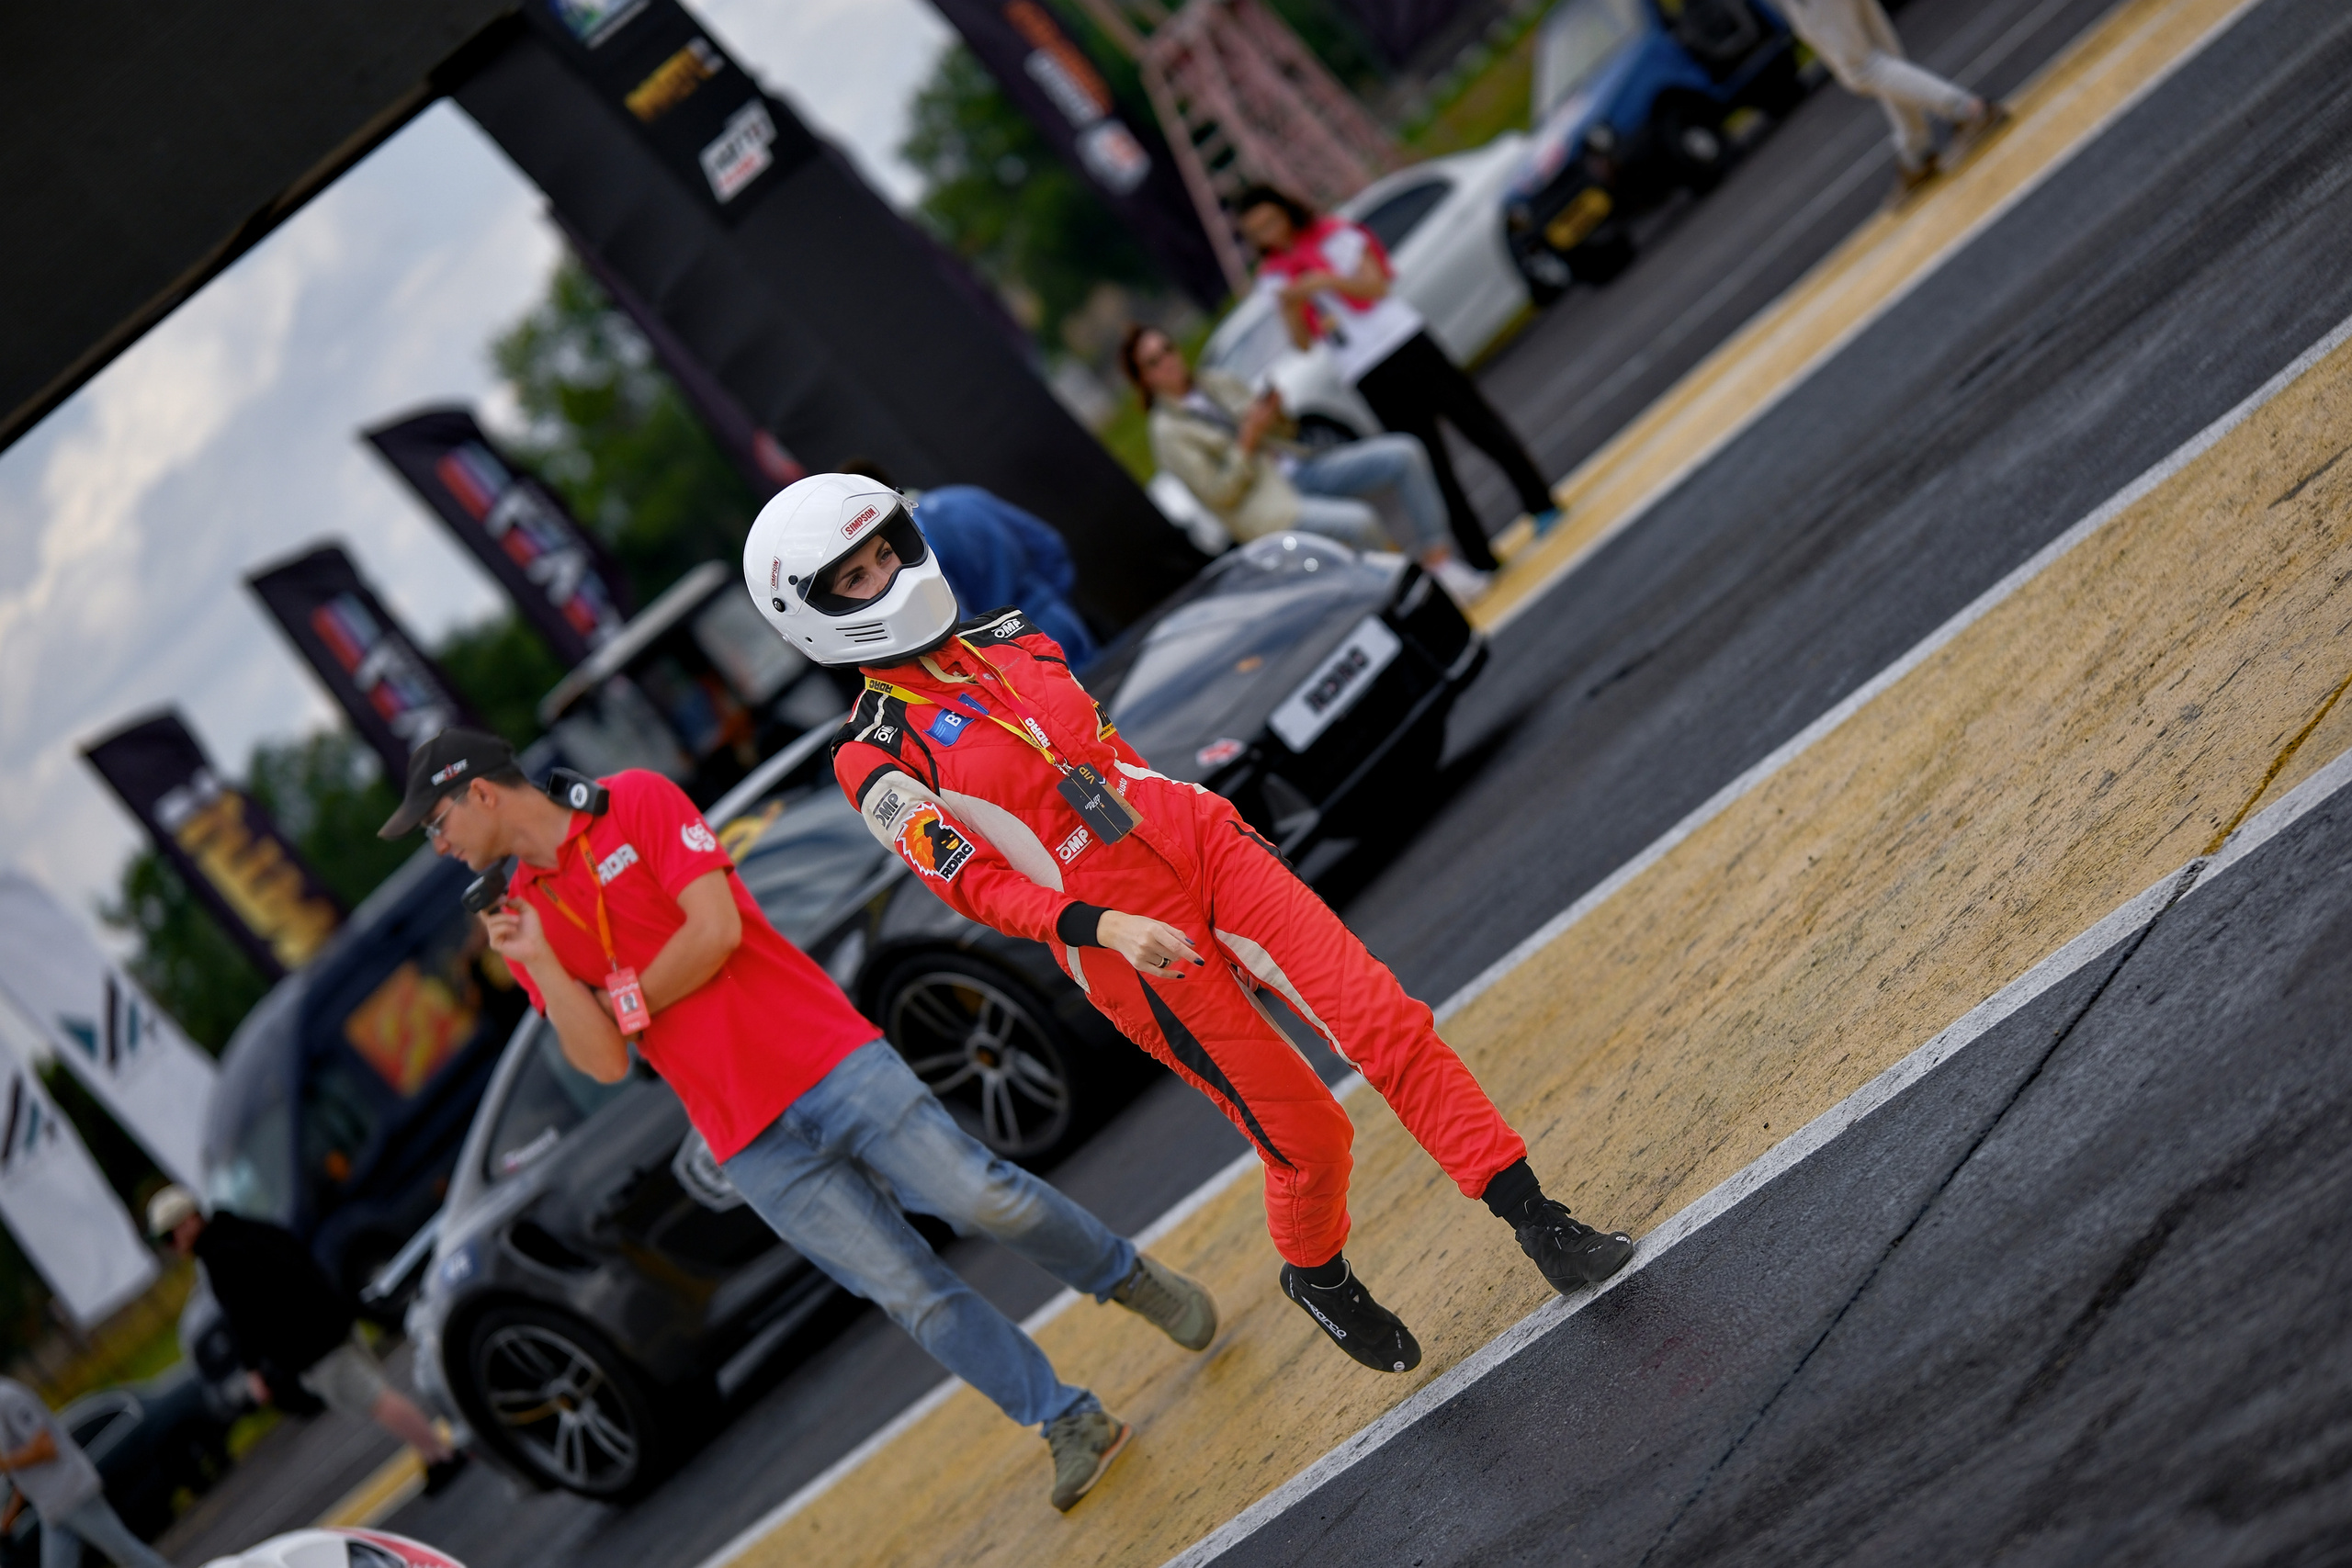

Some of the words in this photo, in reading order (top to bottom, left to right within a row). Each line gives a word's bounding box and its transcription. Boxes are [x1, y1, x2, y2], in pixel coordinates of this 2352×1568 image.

[845, 507, 876, 536] SIMPSON
[993, 619, 1023, 638] OMP
[1079, 766, 1096, 784] VIP
[1058, 829, 1089, 861] OMP
